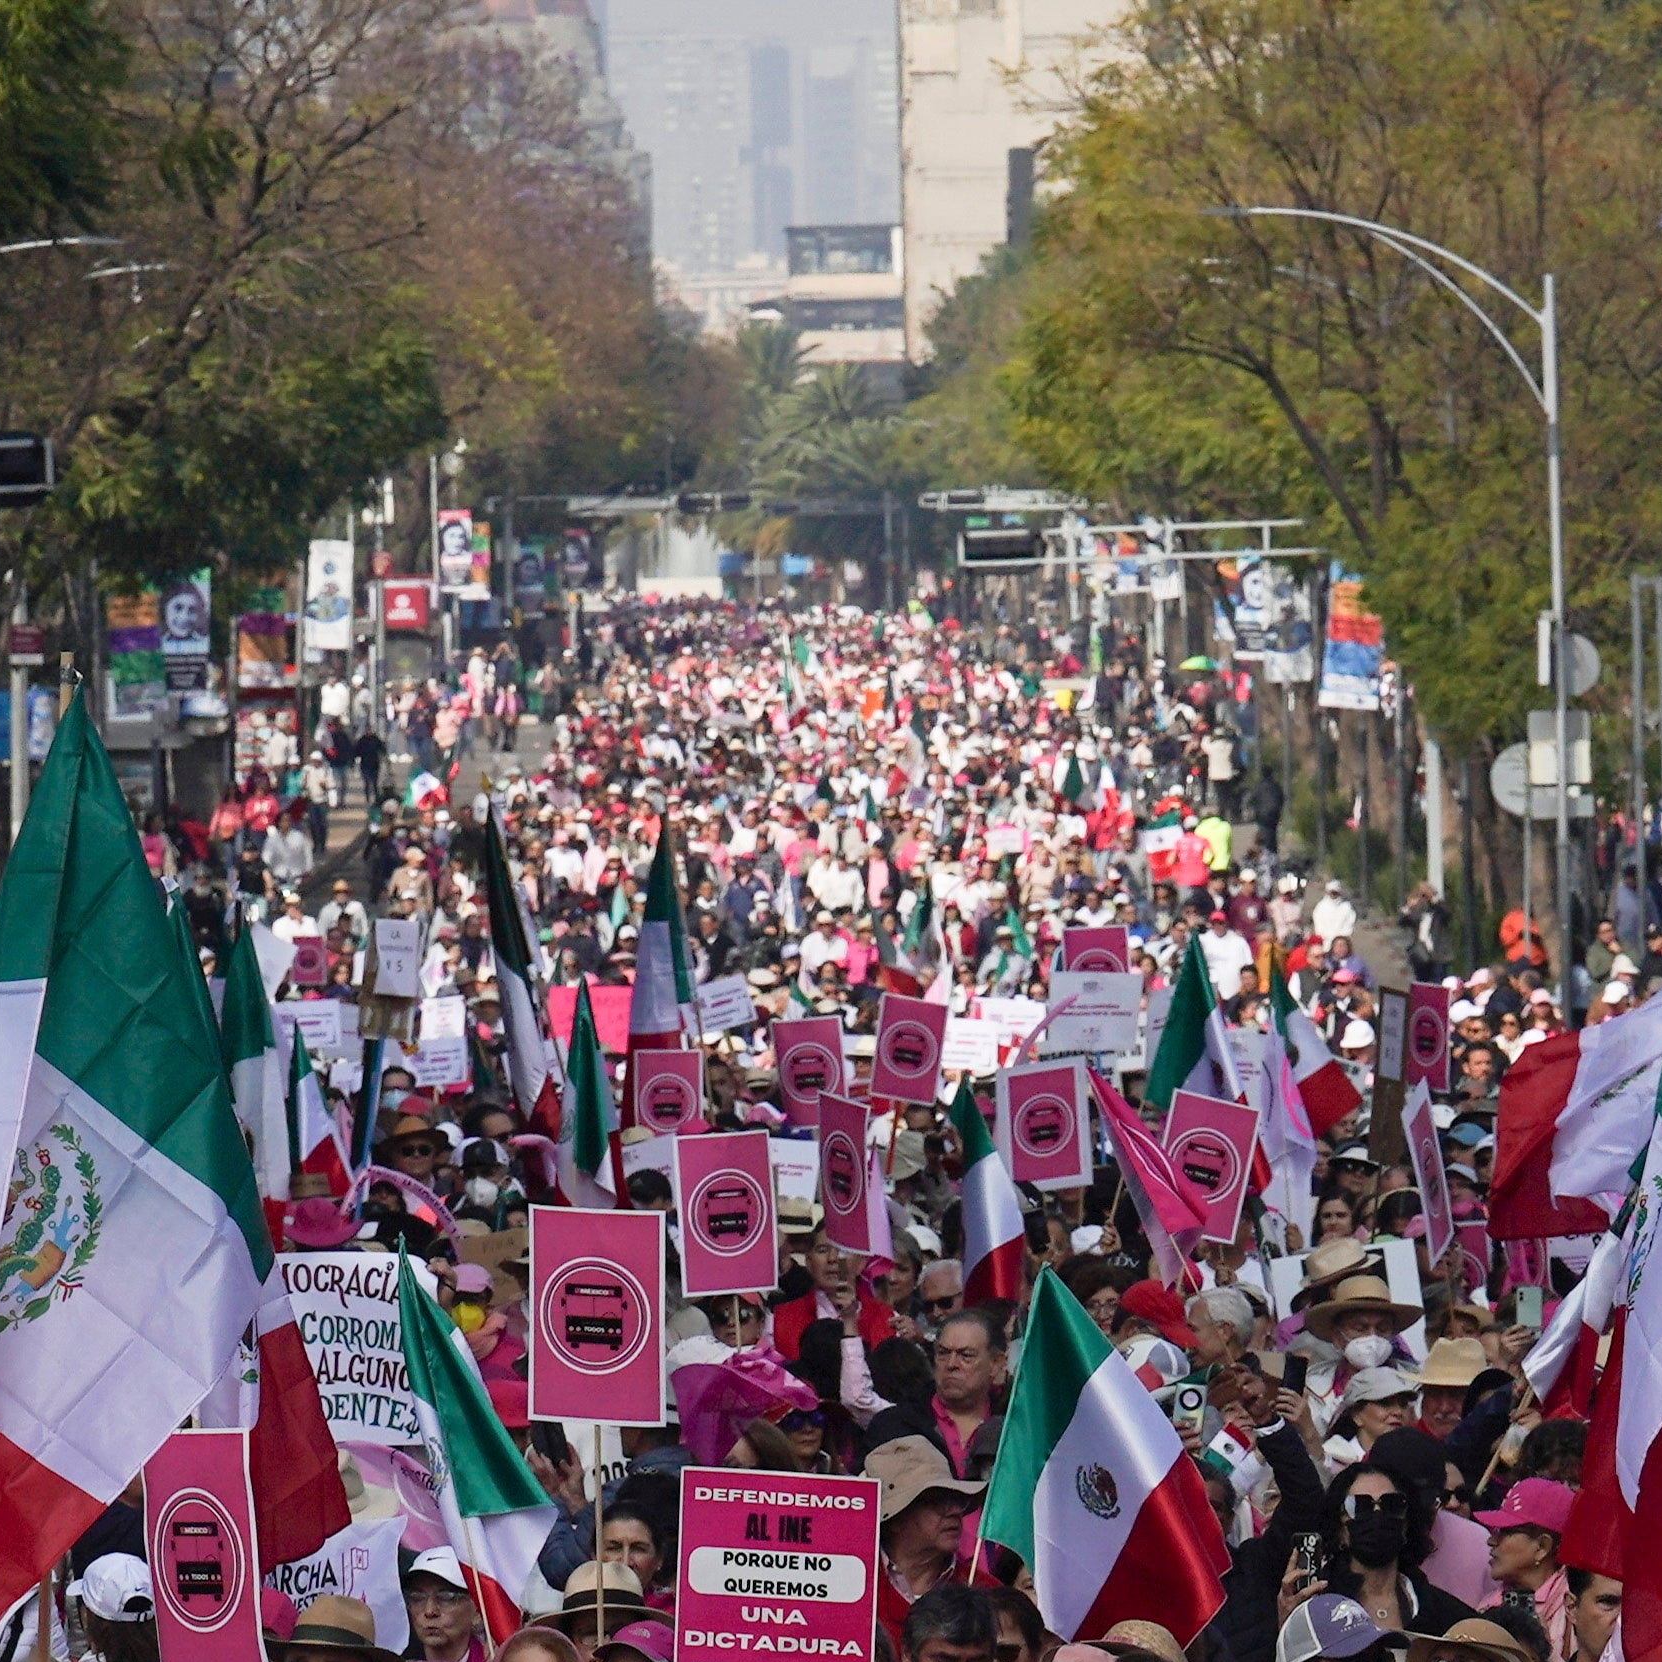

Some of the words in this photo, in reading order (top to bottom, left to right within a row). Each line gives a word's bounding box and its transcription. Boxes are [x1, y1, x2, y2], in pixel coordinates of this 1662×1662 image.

[693, 1486, 865, 1511] DEFENDEMOS
[743, 1513, 770, 1541] AL
[777, 1514, 812, 1544] INE
[722, 1550, 799, 1571] PORQUE
[803, 1555, 831, 1571] NO
[723, 1577, 827, 1598] QUEREMOS
[740, 1604, 808, 1625] UNA
[683, 1628, 863, 1656] DICTADURA
